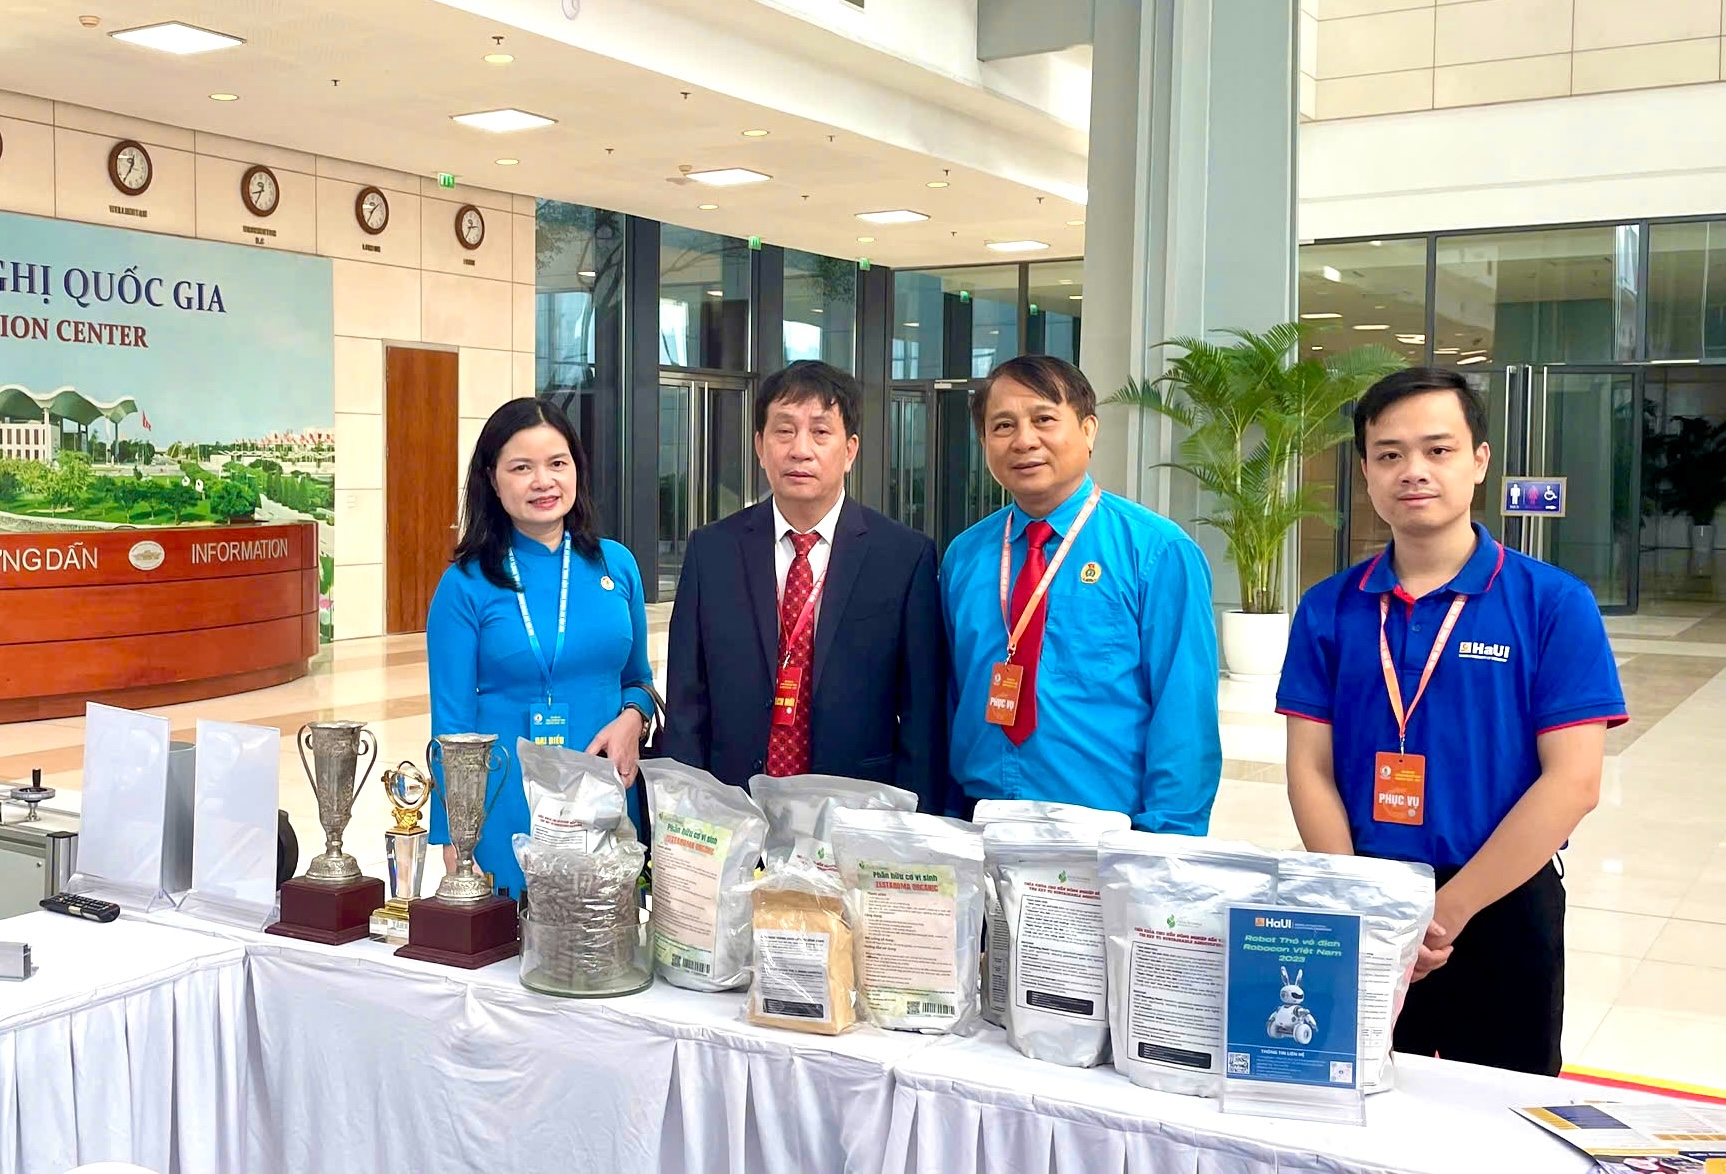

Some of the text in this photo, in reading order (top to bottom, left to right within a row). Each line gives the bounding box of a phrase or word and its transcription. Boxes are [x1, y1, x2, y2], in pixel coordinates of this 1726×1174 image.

[64, 266, 164, 308] QUỐC
[173, 280, 228, 313] GIA
[0, 314, 149, 348] ION CENTER
[0, 541, 98, 572] NG DẪN
[191, 538, 288, 564] INFORMATION
[1472, 642, 1510, 658] HaUI
[1378, 792, 1420, 809] PHỤC VỤ
[1265, 918, 1292, 929] HaUI
[1243, 943, 1290, 952] Robocon
[1293, 946, 1313, 955] Việt
[1279, 955, 1306, 963] 2023
